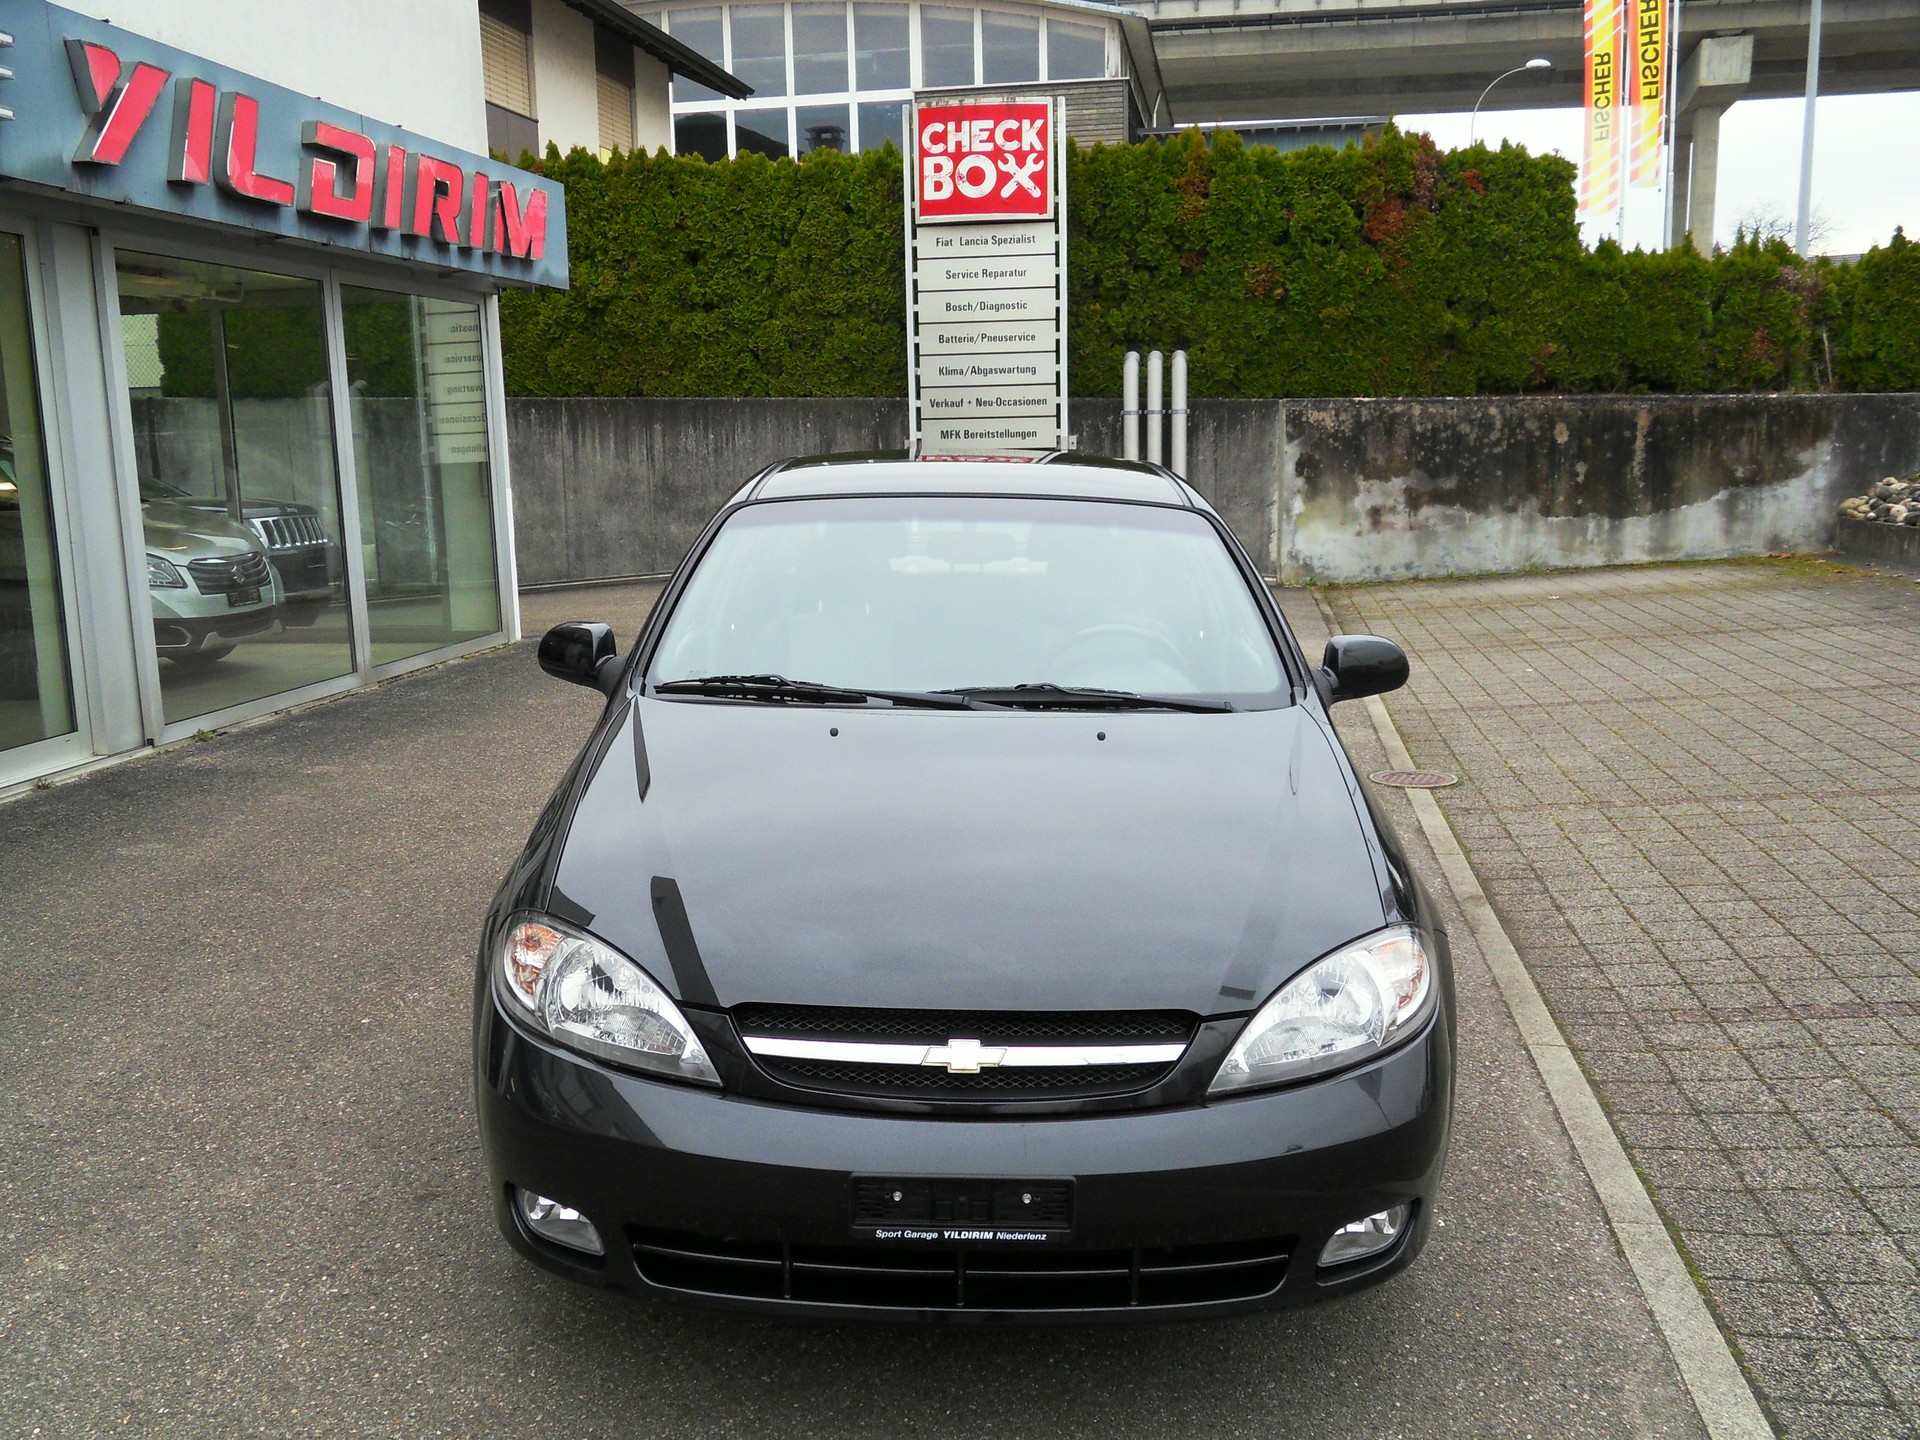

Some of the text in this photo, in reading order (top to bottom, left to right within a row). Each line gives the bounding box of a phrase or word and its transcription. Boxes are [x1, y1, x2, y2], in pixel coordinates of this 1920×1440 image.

[921, 119, 1045, 154] CHECK
[63, 36, 548, 261] YILDIRIM
[923, 153, 1044, 201] BOX
[936, 234, 1036, 247] Fiat Lancia Spezialist
[945, 268, 1027, 280] Service Reparatur
[945, 300, 1028, 313] Bosch/Diagnostic
[938, 332, 1036, 345] Batterie/Pneuservice
[938, 365, 1037, 377] Klima/Abgaswartung
[929, 398, 964, 409] Verkauf
[975, 396, 1048, 407] Neu-Occasionen
[940, 428, 1038, 440] MFK Bereitstellungen
[875, 1229, 1047, 1241] Sport Garage YILDIRIM Niederlenz
